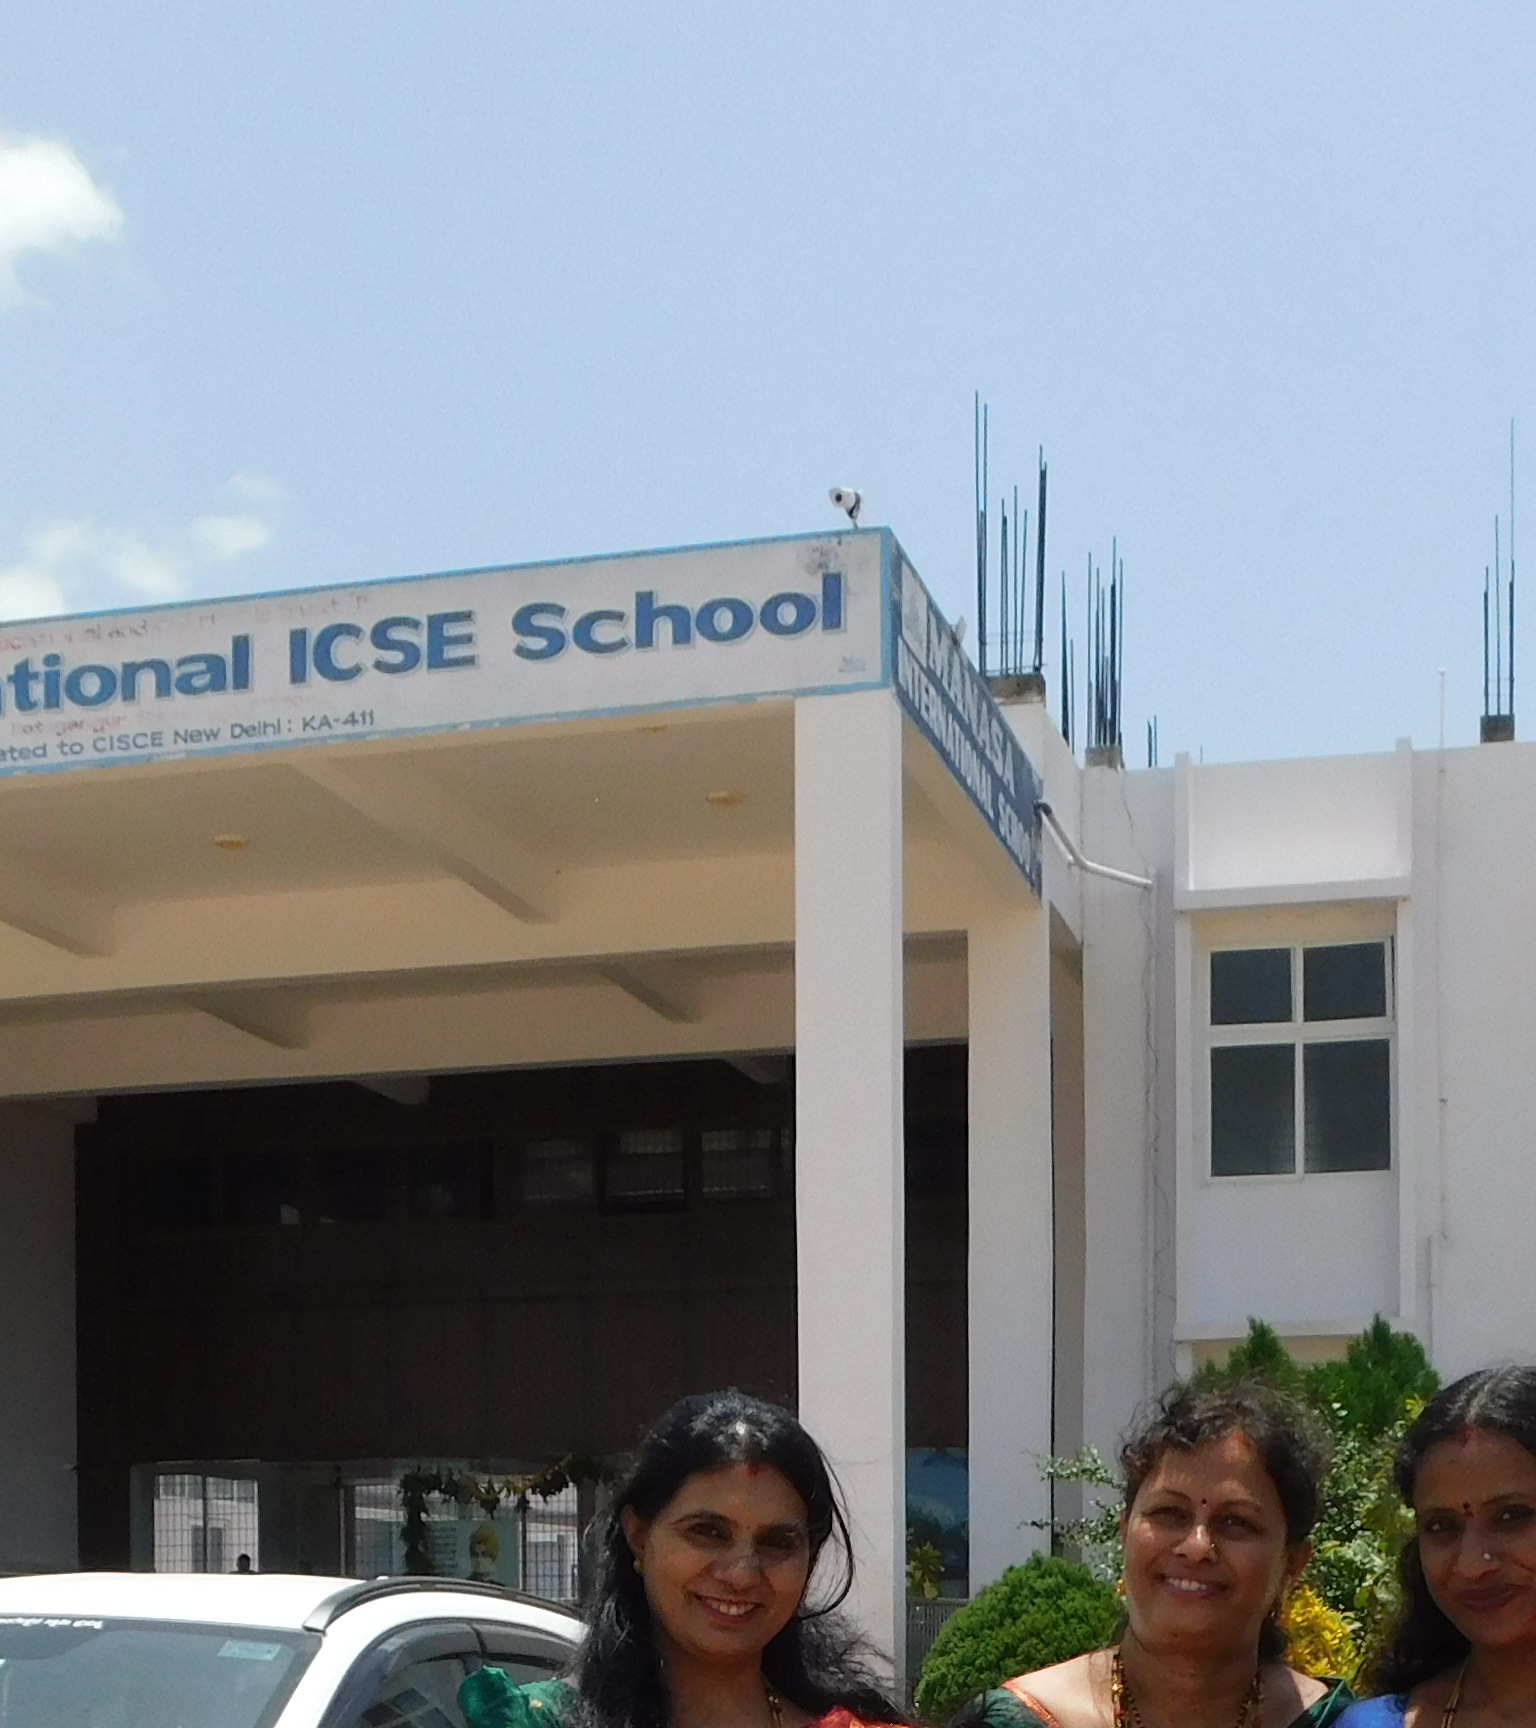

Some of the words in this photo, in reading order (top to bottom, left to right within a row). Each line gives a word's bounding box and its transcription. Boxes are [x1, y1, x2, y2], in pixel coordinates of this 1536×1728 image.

[289, 610, 480, 686] ICSE
[510, 571, 846, 664] School
[57, 738, 85, 756] to
[92, 730, 164, 752] CISCE
[172, 726, 221, 745] New
[230, 717, 282, 740] Delhi
[301, 708, 375, 733] KA-411
